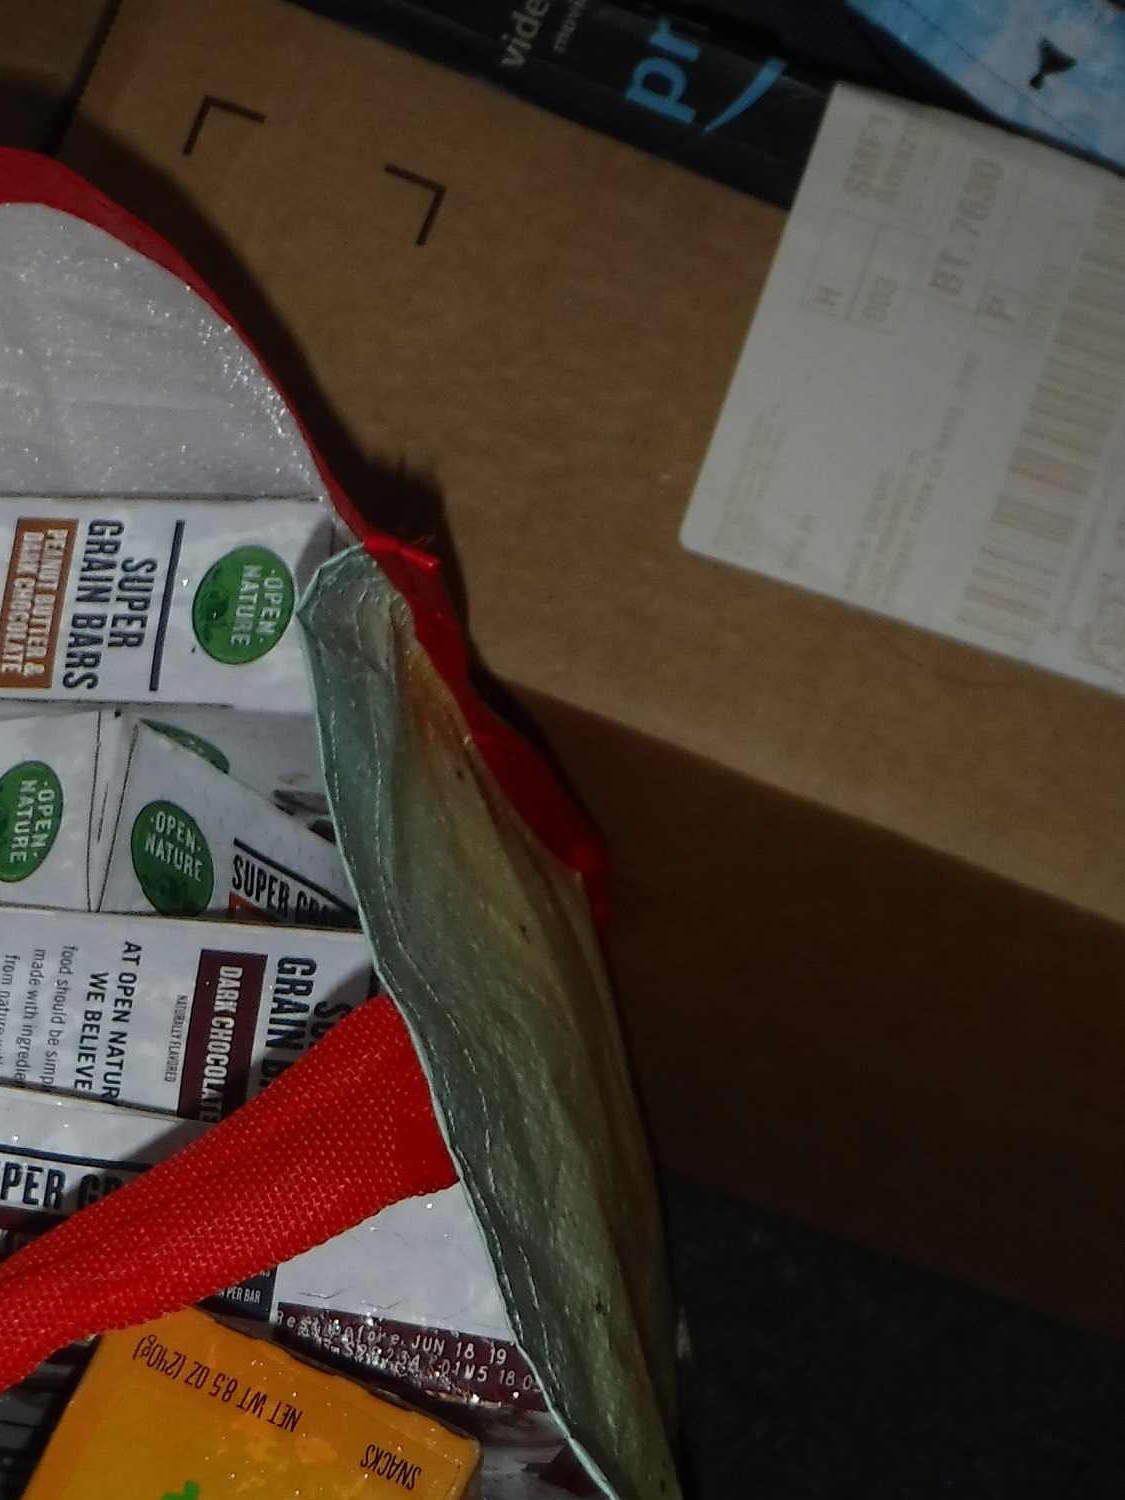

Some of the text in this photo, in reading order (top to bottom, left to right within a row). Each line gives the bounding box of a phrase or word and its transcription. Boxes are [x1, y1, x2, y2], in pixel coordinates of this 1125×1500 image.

[0, 532, 44, 675] DARK CHOCOLATE
[23, 529, 68, 677] PEANUT BUTTER &
[61, 520, 124, 691] GRAIN BARS
[107, 557, 158, 649] SUPER
[230, 564, 263, 647] NATURE
[258, 577, 284, 637] OPEN
[10, 780, 37, 864] NATURE
[31, 789, 55, 848] OPEN
[156, 810, 198, 851] OPEN
[145, 832, 204, 882] NATURE
[232, 854, 290, 918] SUPER
[0, 954, 21, 985] from
[21, 949, 47, 1021] made with
[122, 941, 142, 966] AT
[47, 945, 78, 1048] food should be
[112, 972, 138, 1023] OPEN
[214, 965, 245, 1012] DARK
[264, 957, 318, 1049] GRAIN
[74, 972, 109, 1091] WE BELIEVE
[163, 994, 189, 1083] NATURALLY FLAVORED
[226, 1285, 244, 1301] PER
[244, 1287, 262, 1304] BAR
[132, 1335, 303, 1433] NET WT 8.5 OZ (240g)
[412, 1334, 446, 1356] JUN
[455, 1341, 475, 1360] 18
[488, 1344, 508, 1366] 19
[360, 1443, 422, 1491] SNACKS
